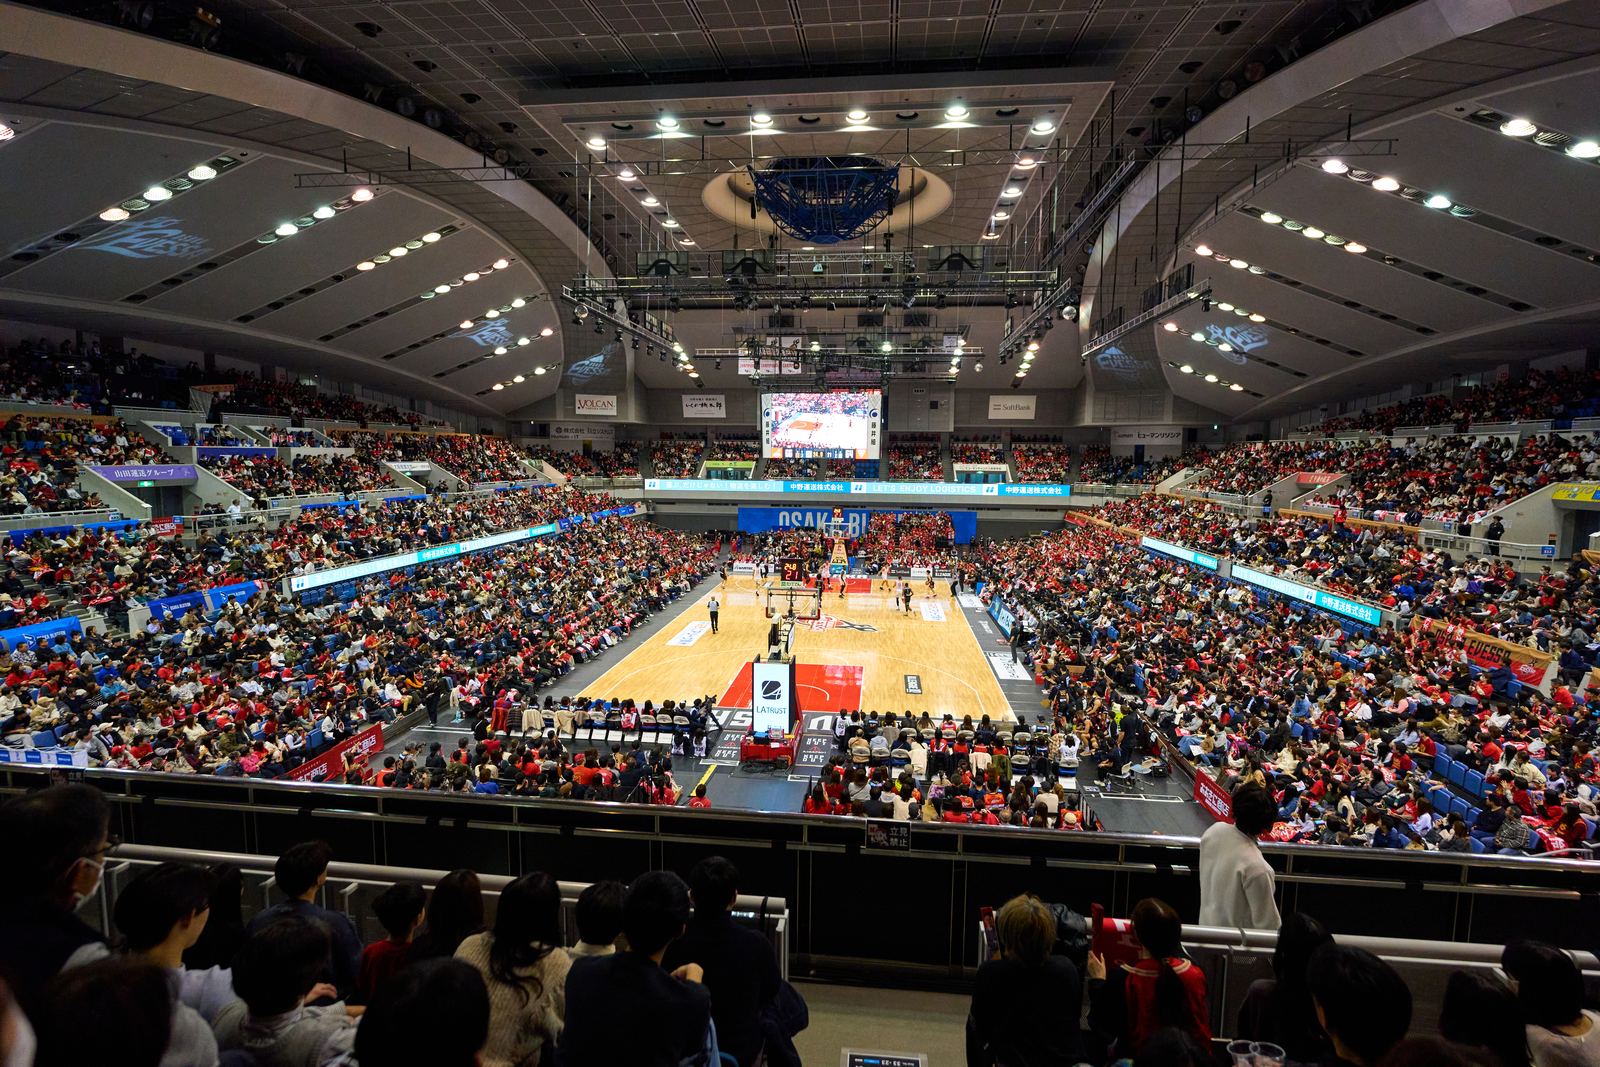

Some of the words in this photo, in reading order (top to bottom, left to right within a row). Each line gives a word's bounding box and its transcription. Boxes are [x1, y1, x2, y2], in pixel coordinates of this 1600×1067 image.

[790, 483, 844, 492] 中野運送株式会社
[899, 485, 928, 493] ENJOY
[930, 485, 977, 493] LOGISTICS
[1005, 486, 1063, 495] 中野運送株式会社
[1321, 595, 1373, 622] 中野運送株式会社
